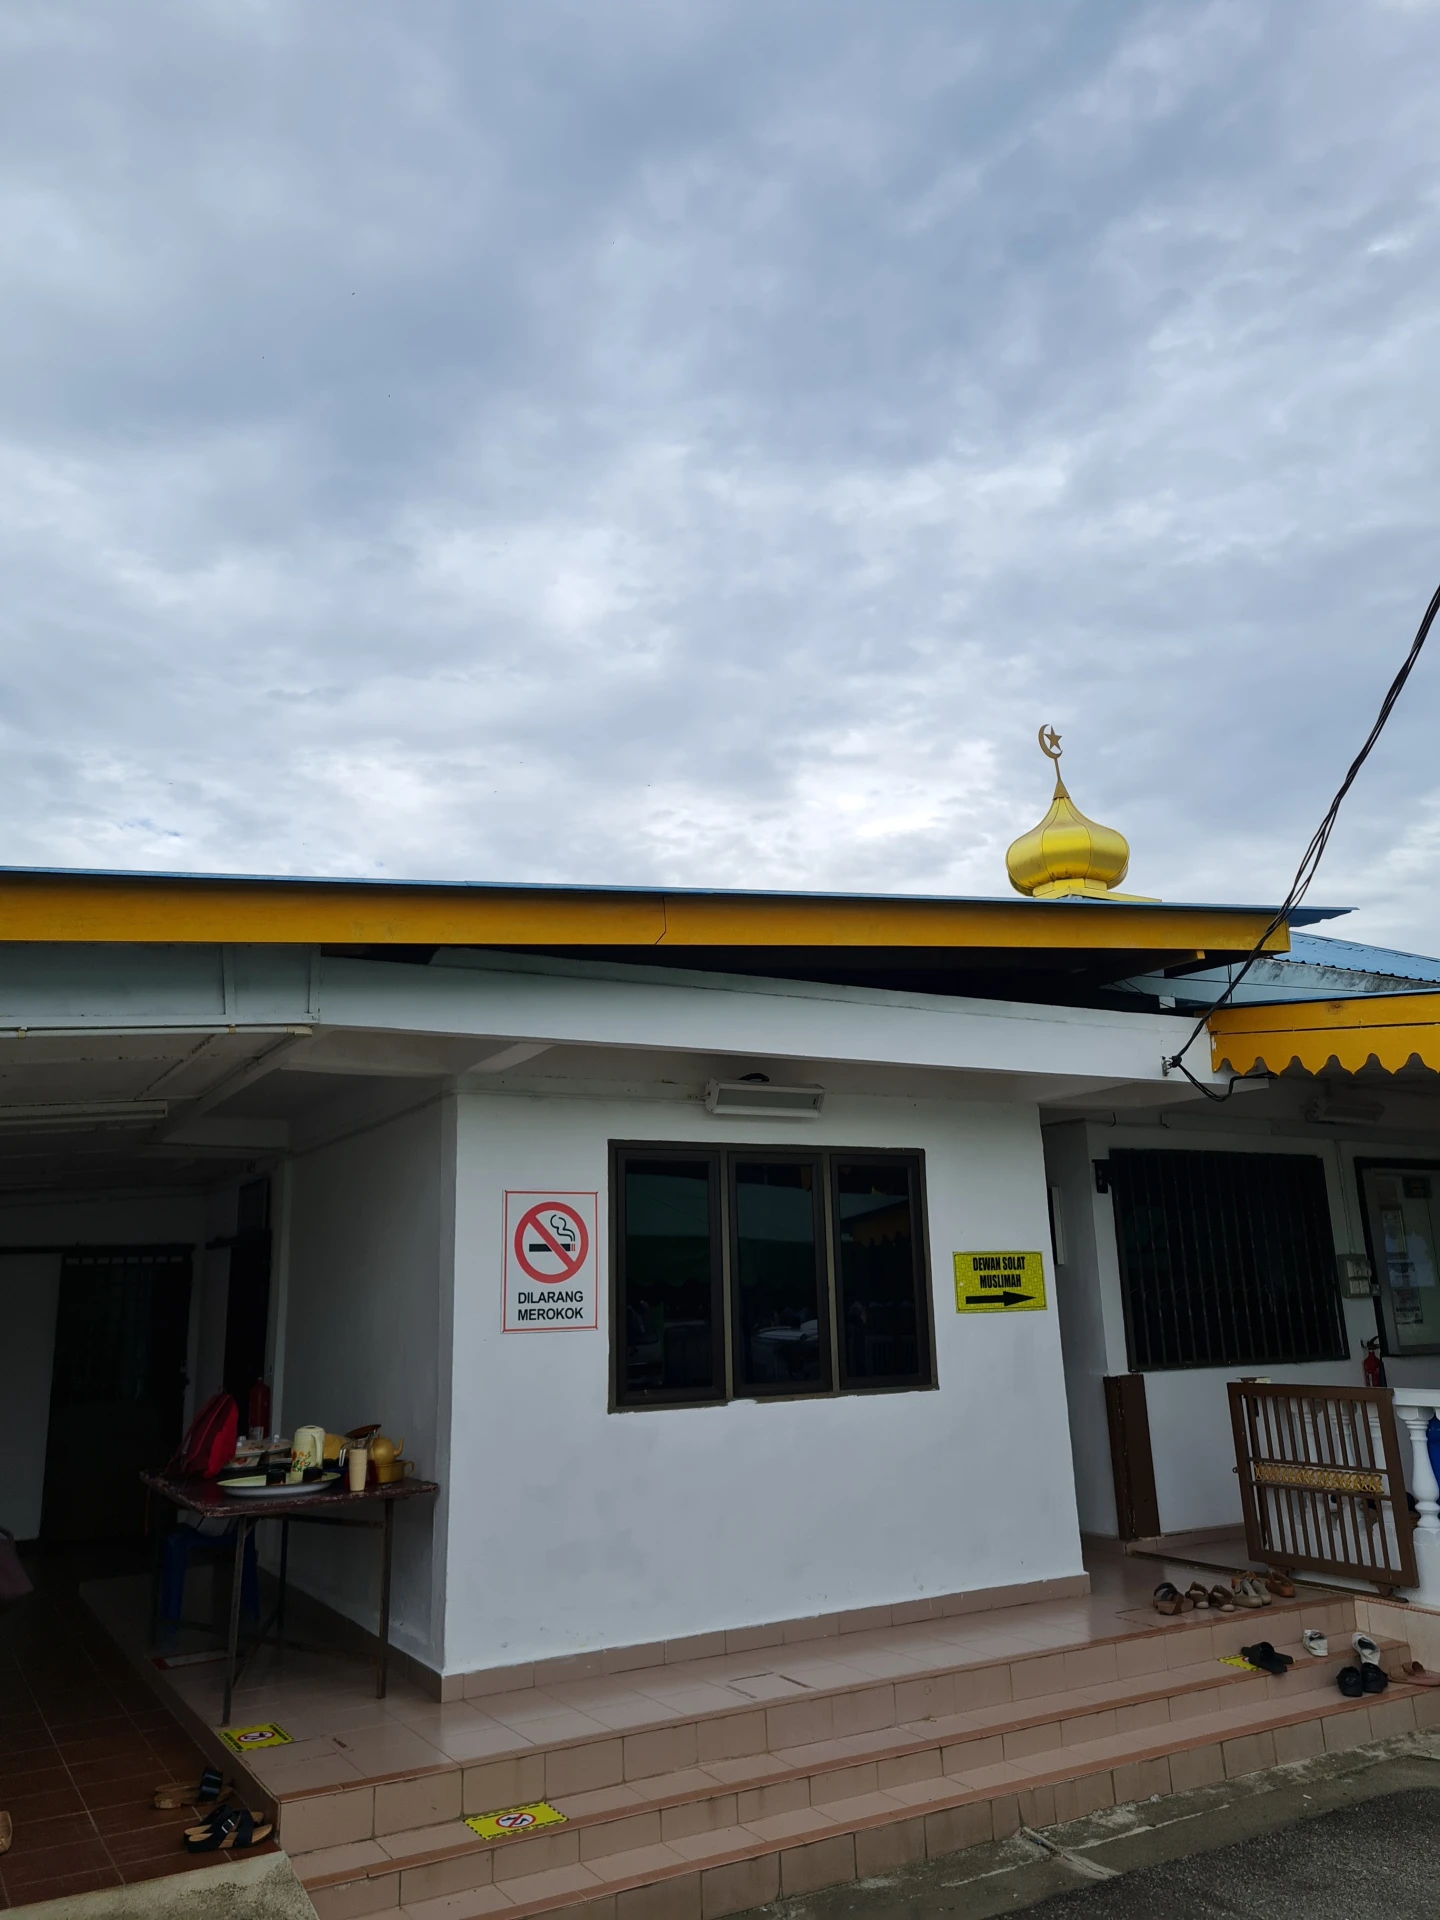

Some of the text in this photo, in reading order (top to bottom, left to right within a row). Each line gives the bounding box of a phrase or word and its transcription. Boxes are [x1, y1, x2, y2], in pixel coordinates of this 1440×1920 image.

[973, 1256, 1025, 1270] DEWAN SOLAT
[980, 1274, 1021, 1288] MUSLIMAH
[518, 1291, 584, 1304] DILARANG
[518, 1307, 584, 1321] MEROKOK
